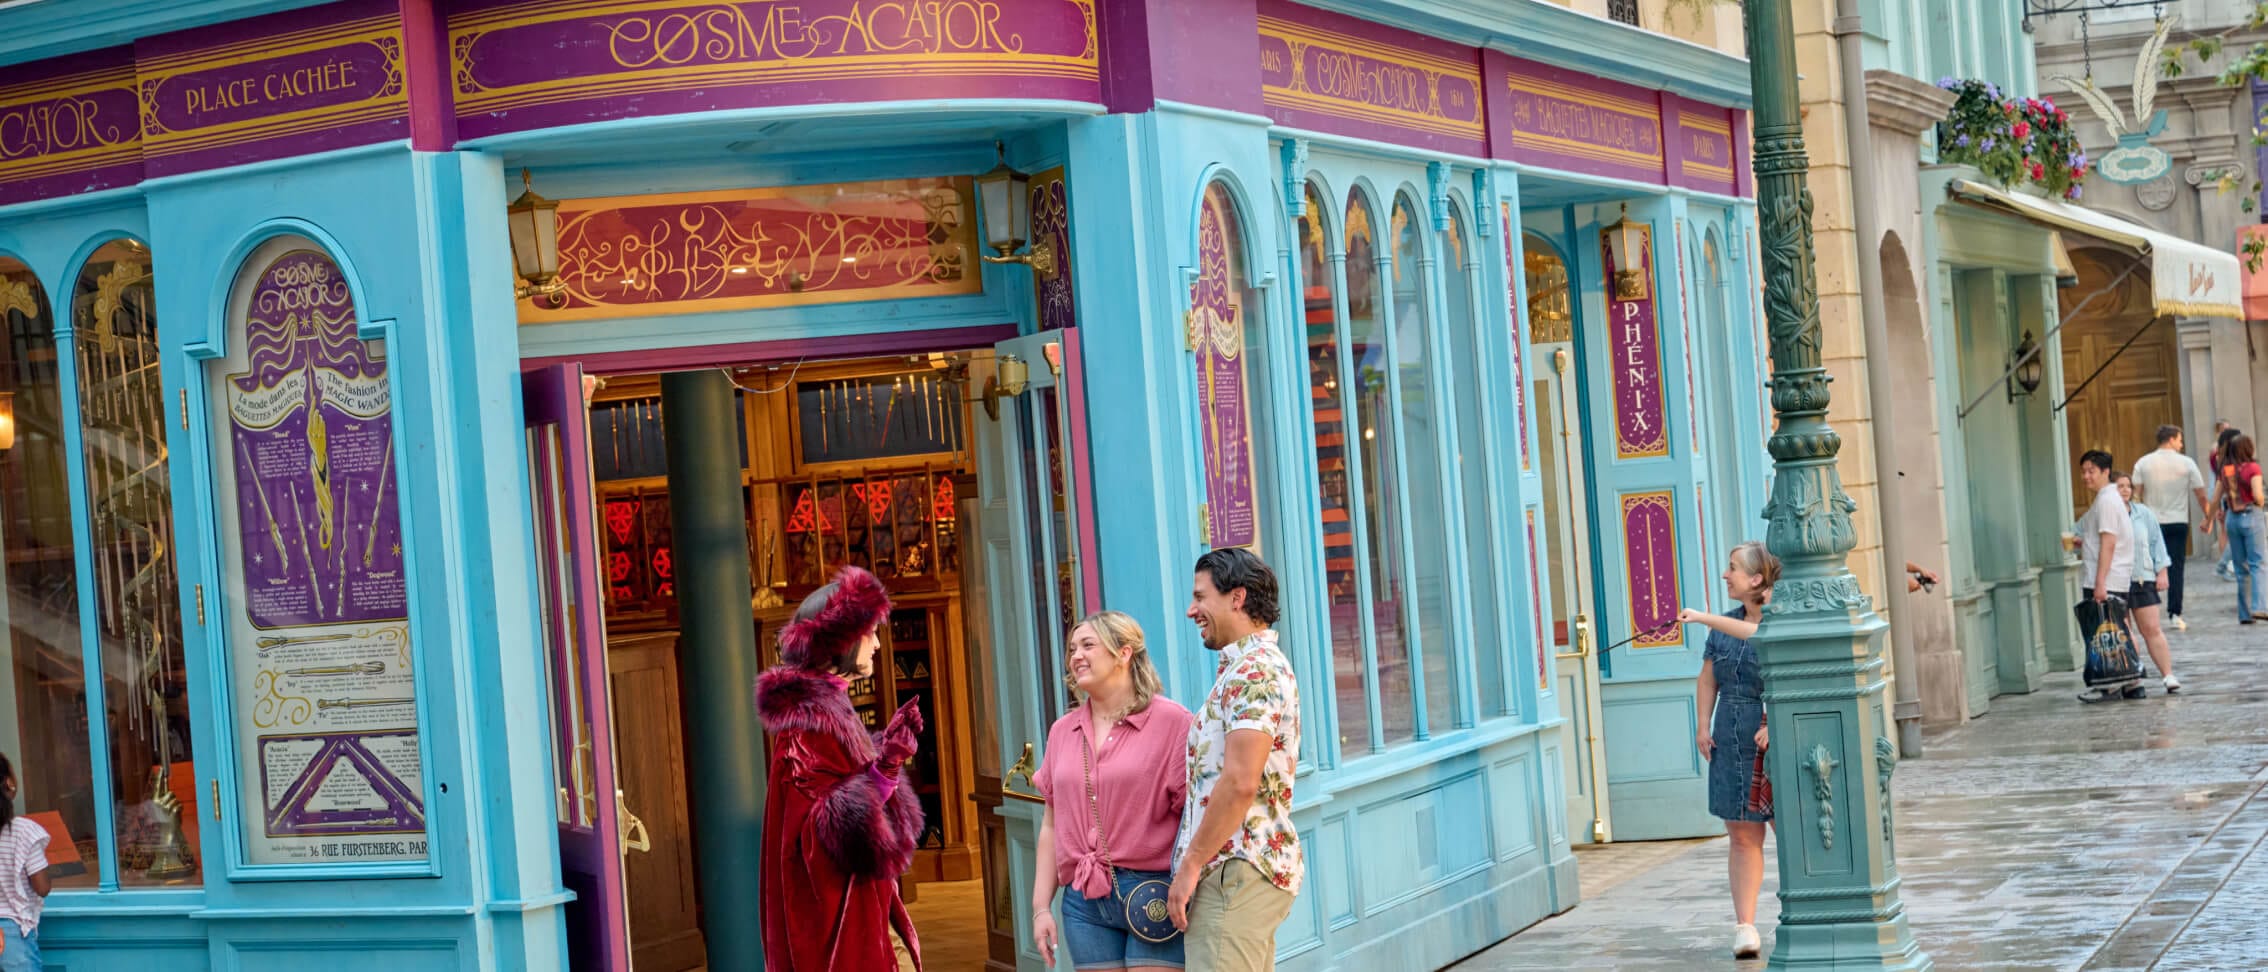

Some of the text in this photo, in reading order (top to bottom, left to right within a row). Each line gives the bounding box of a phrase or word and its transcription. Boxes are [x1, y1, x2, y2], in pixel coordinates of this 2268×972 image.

[594, 0, 1022, 68] COSME ACAJOR
[185, 58, 356, 115] PLACE CACHÉE
[1261, 50, 1281, 73] ARIS
[1316, 52, 1368, 103] COSME
[0, 97, 120, 157] CAJOR
[271, 262, 329, 287] COSME
[259, 282, 349, 314] ACAJOR
[1623, 301, 1648, 431] PHÉNIX
[238, 379, 298, 409] La mode dans les
[326, 385, 355, 407] MAGIC
[328, 372, 388, 396] The fashion in
[310, 845, 319, 857] 36
[321, 843, 339, 857] RUE
[410, 841, 428, 854] PAR
